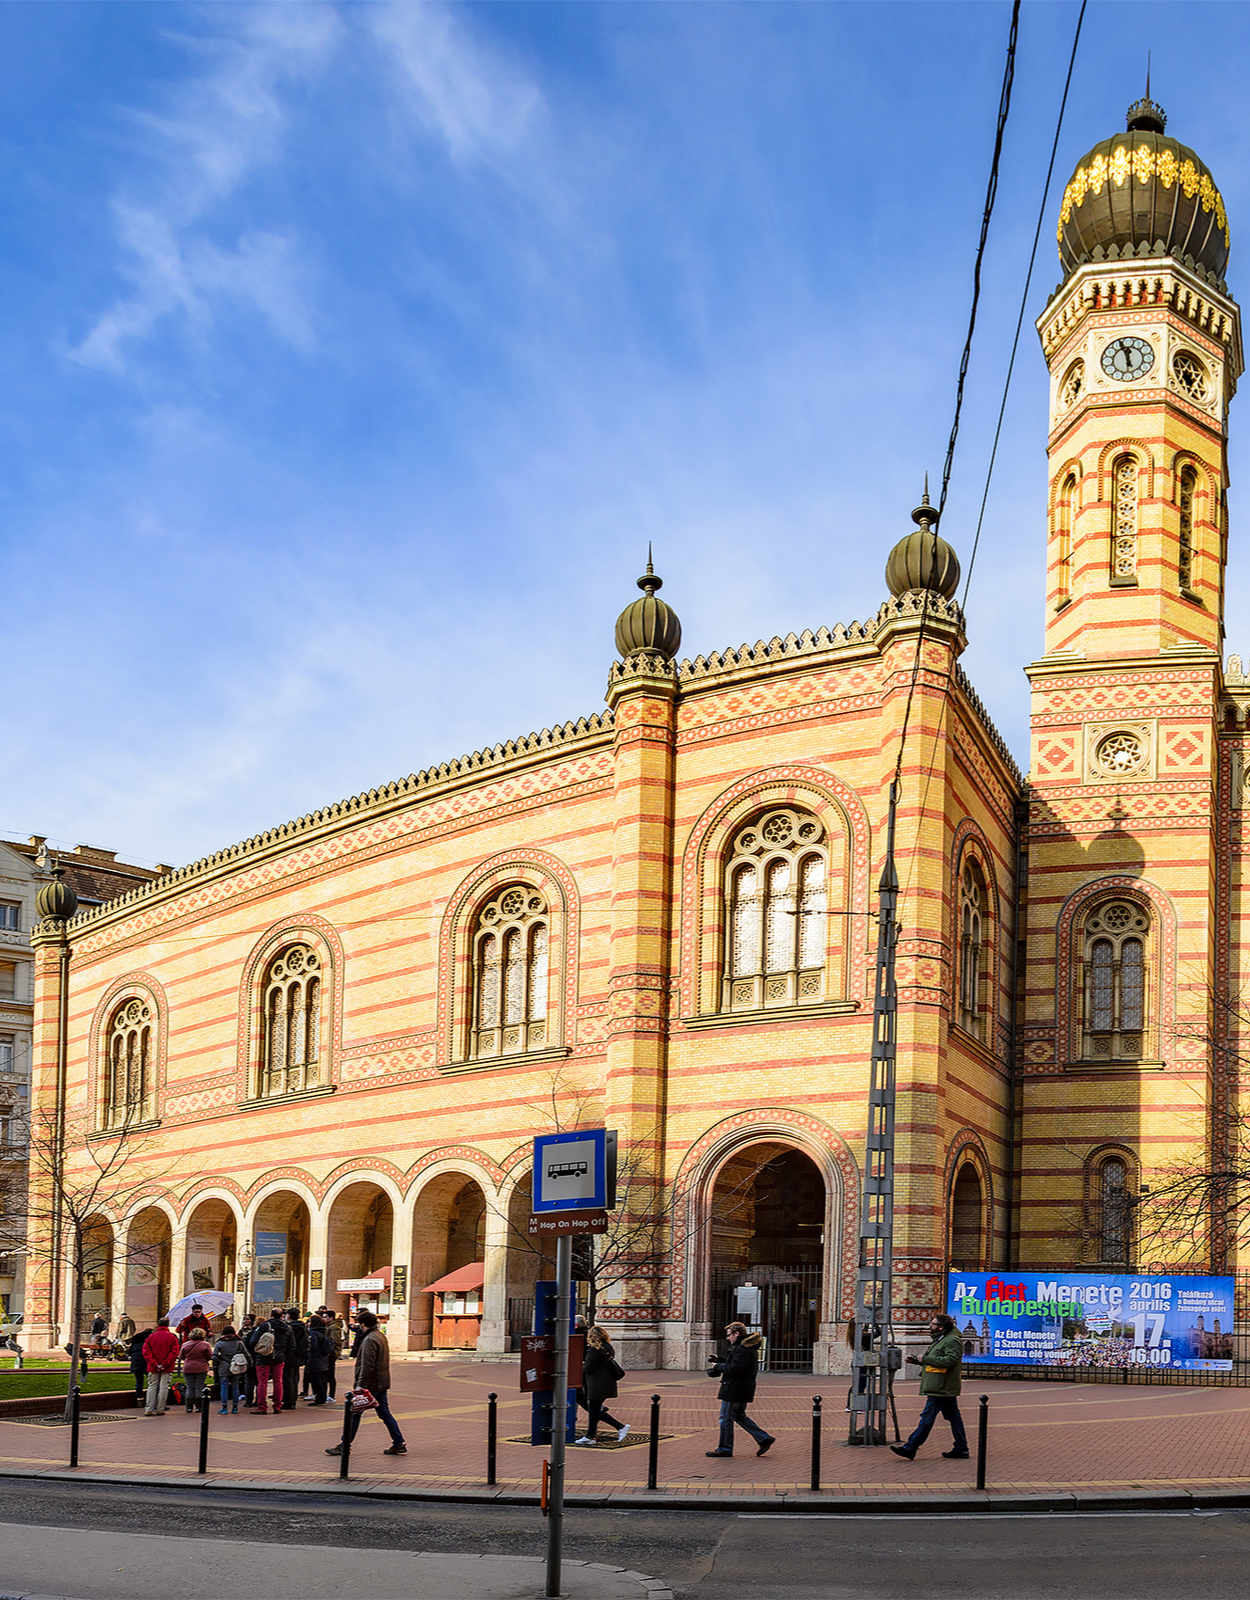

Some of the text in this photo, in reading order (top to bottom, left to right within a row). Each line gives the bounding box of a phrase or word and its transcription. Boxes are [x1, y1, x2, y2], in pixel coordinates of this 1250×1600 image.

[540, 1218, 606, 1230] Hop On Hop Off
[954, 1276, 1123, 1305] Az Élet Menete
[1129, 1282, 1172, 1299] 2016
[961, 1295, 1082, 1319] Budapesten
[1129, 1299, 1171, 1312] április
[994, 1329, 1056, 1340] Az Élet Menete
[1128, 1313, 1171, 1347] 17.
[1001, 1339, 1025, 1348] Szent
[1026, 1340, 1053, 1349] István
[994, 1349, 1028, 1357] Bazilika
